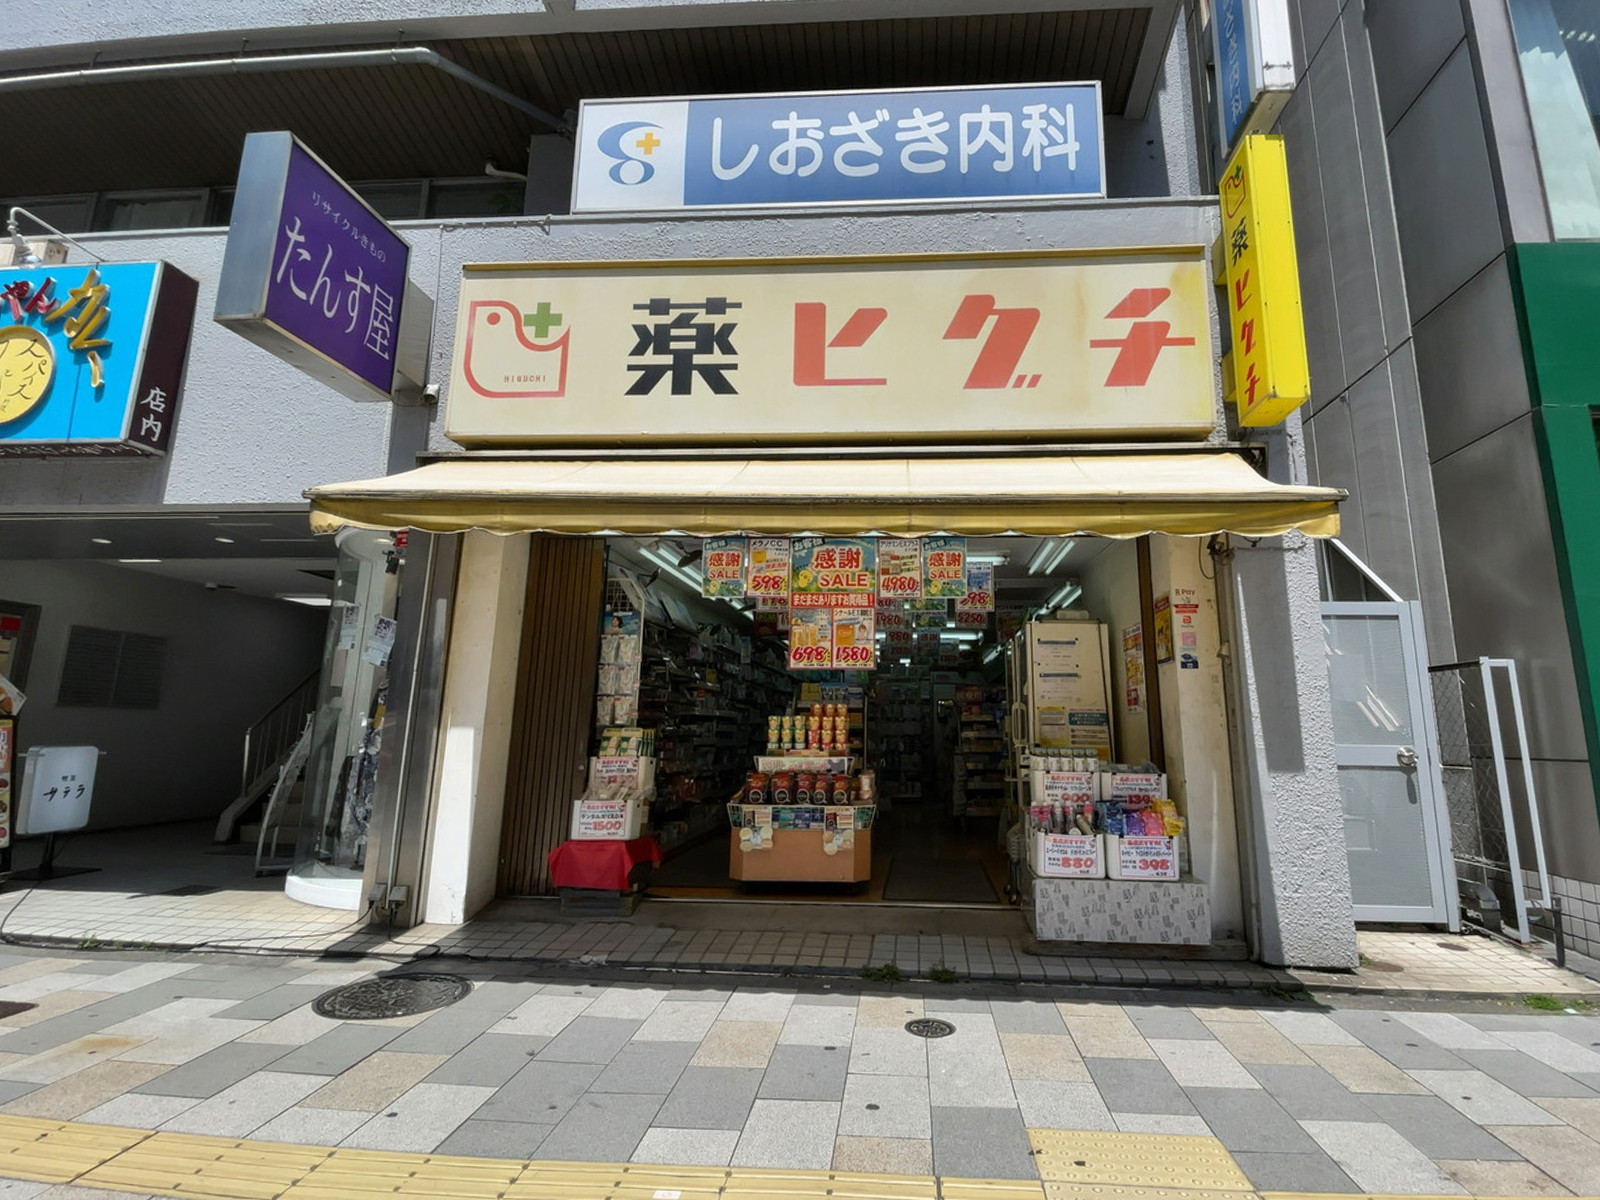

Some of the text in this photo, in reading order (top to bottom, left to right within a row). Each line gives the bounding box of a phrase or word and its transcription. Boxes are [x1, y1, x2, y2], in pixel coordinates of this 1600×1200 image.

[710, 101, 1080, 181] しおざき内科
[311, 190, 387, 263] リサイクルきもの
[275, 215, 394, 361] たんす屋
[503, 375, 546, 383] HIGUCHI
[140, 387, 168, 442] 店内
[708, 552, 741, 567] 感謝
[814, 547, 862, 569] 感謝
[929, 552, 962, 567] 感謝
[709, 569, 739, 579] SALE
[820, 573, 868, 587] SALE
[930, 569, 961, 579] SALE
[751, 575, 784, 591] 598
[881, 576, 917, 592] 4980
[792, 646, 826, 662] 698
[835, 646, 872, 662] 1580
[43, 784, 86, 801] サテラ
[593, 821, 622, 830] 1500
[1138, 859, 1169, 870] 398
